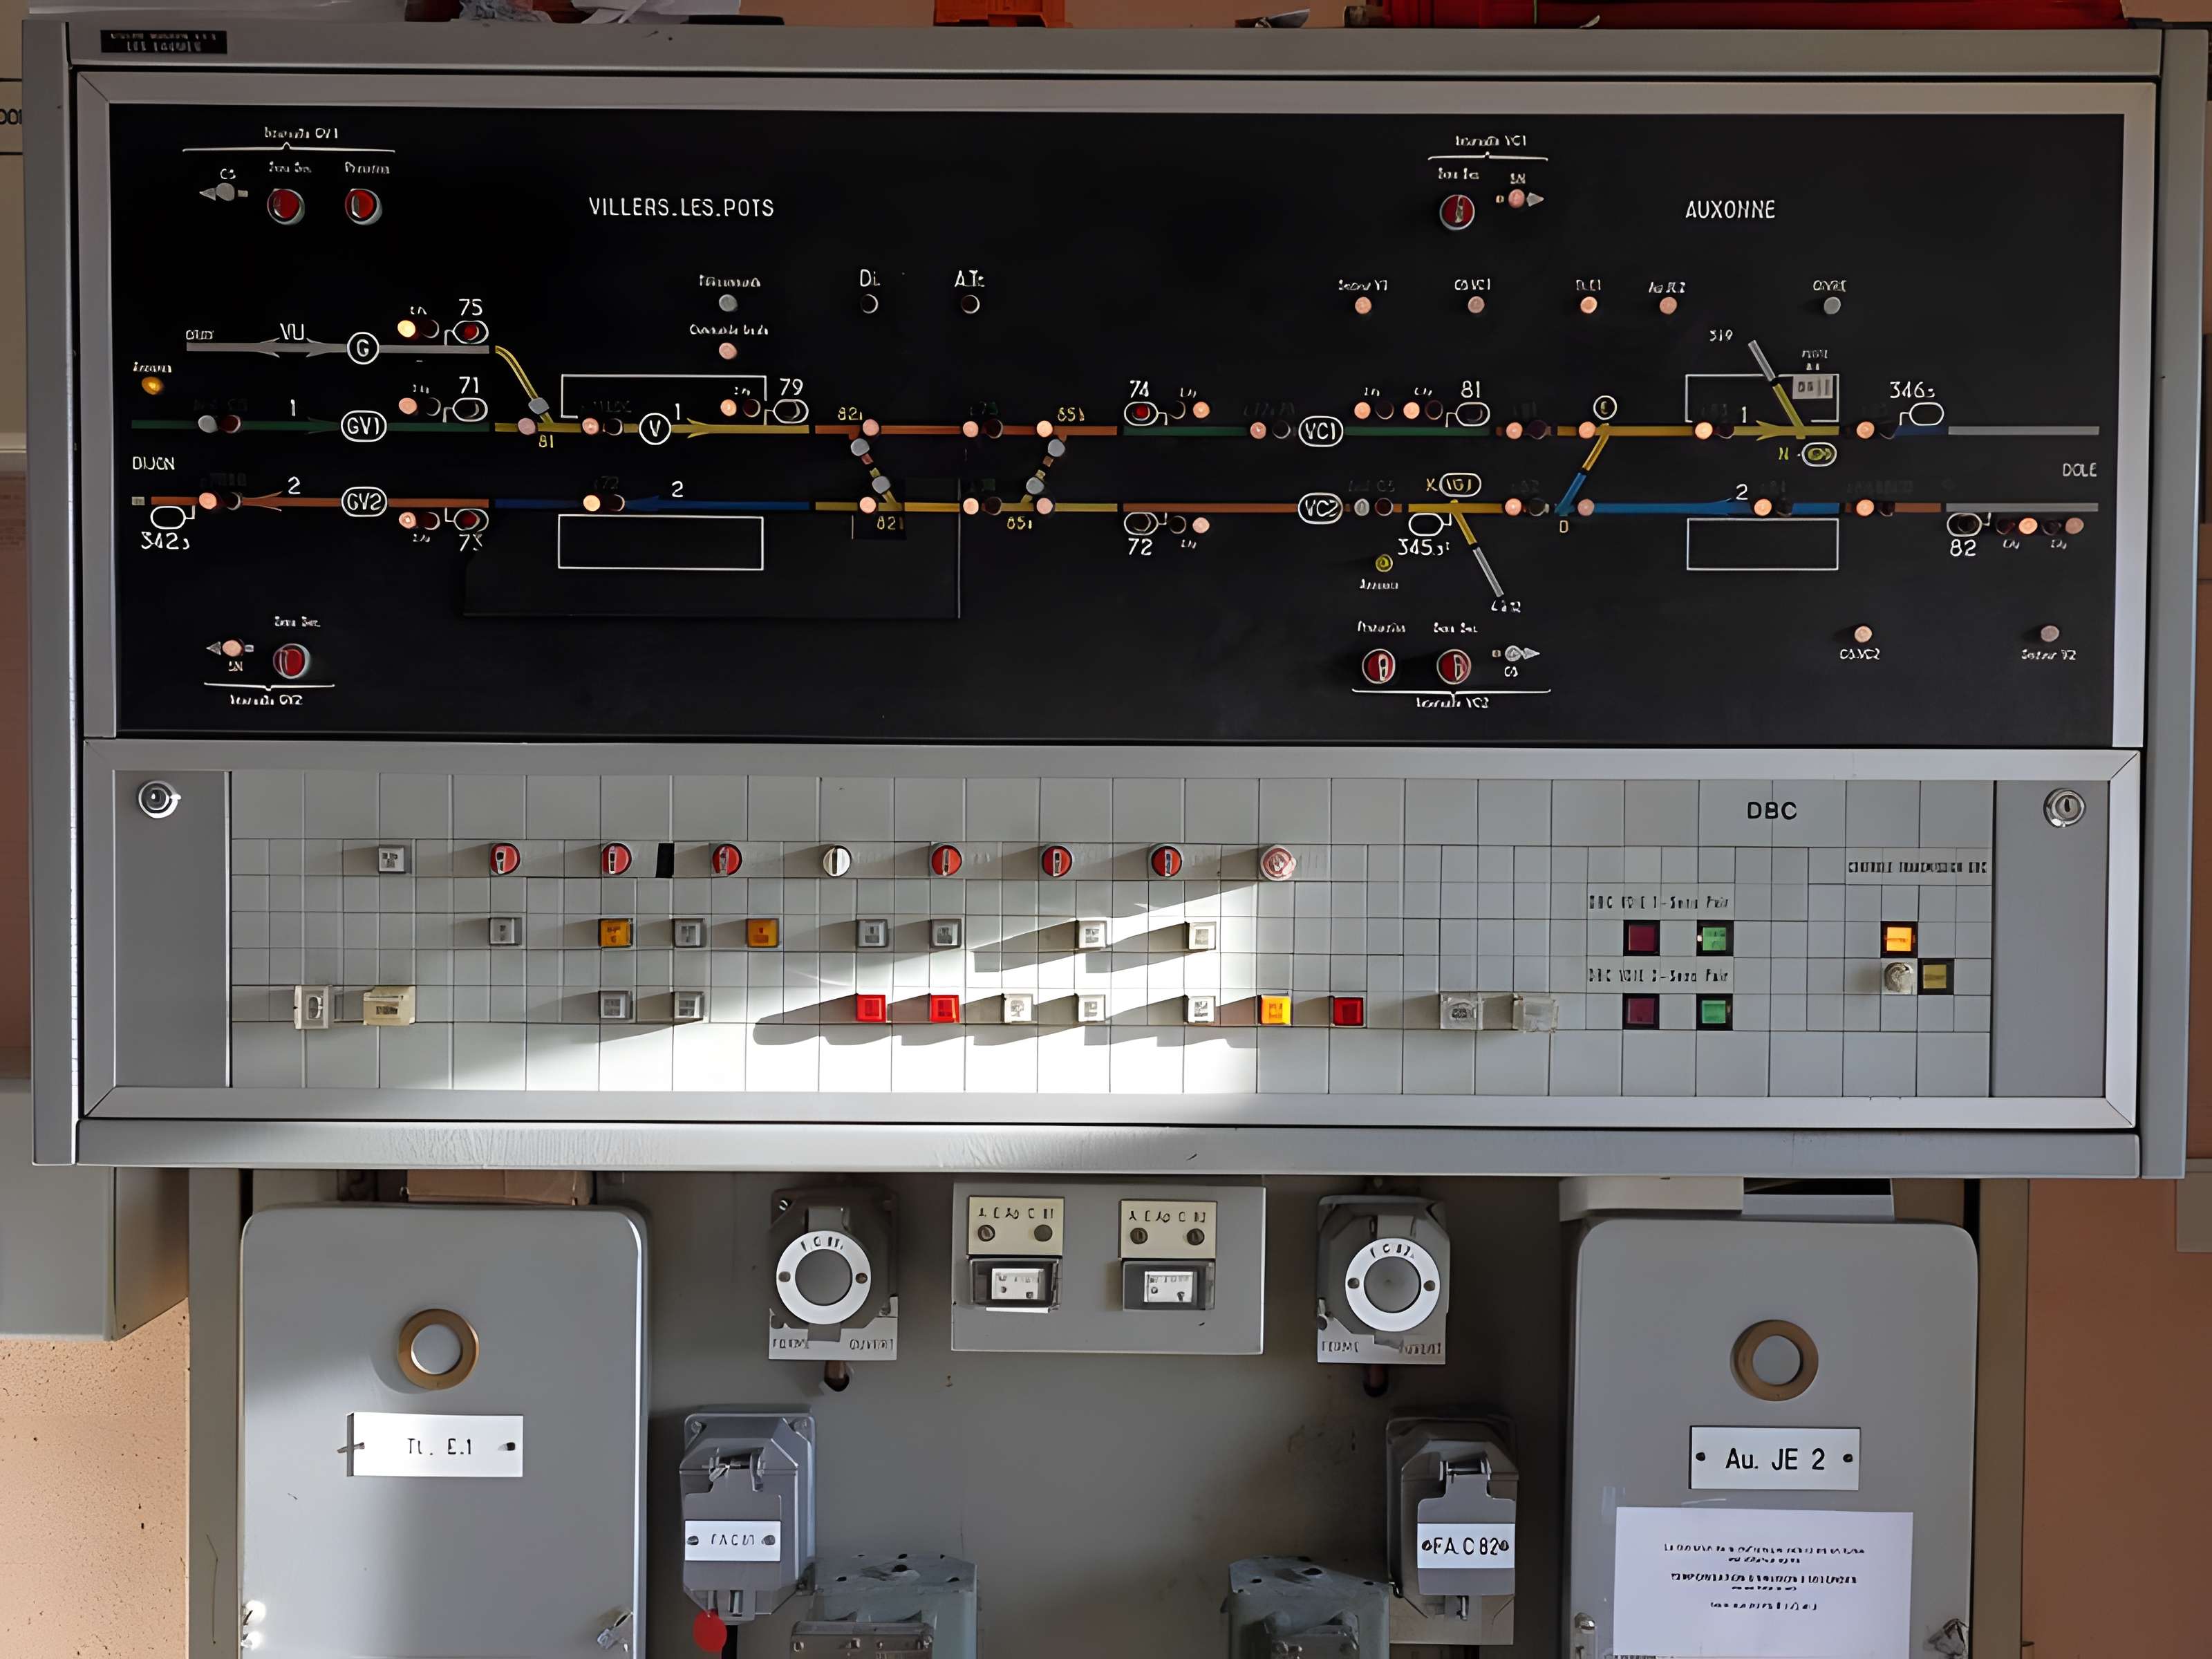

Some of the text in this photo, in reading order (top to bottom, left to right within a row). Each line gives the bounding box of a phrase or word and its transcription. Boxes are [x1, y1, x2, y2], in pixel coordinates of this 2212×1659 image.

[1686, 200, 1774, 218] AUXONNE
[459, 299, 482, 315] 75
[460, 377, 478, 393] 71
[780, 378, 803, 395] 79
[1461, 381, 1479, 397] 81
[347, 418, 380, 435] GV1
[650, 419, 662, 437] V
[288, 476, 300, 494] 2
[672, 481, 683, 497] 2
[1736, 484, 1747, 500] 2
[1129, 538, 1152, 555] 72
[1950, 538, 1976, 556] 82
[1747, 802, 1797, 820] DBC
[1725, 1448, 1824, 1470] Au. JE 2
